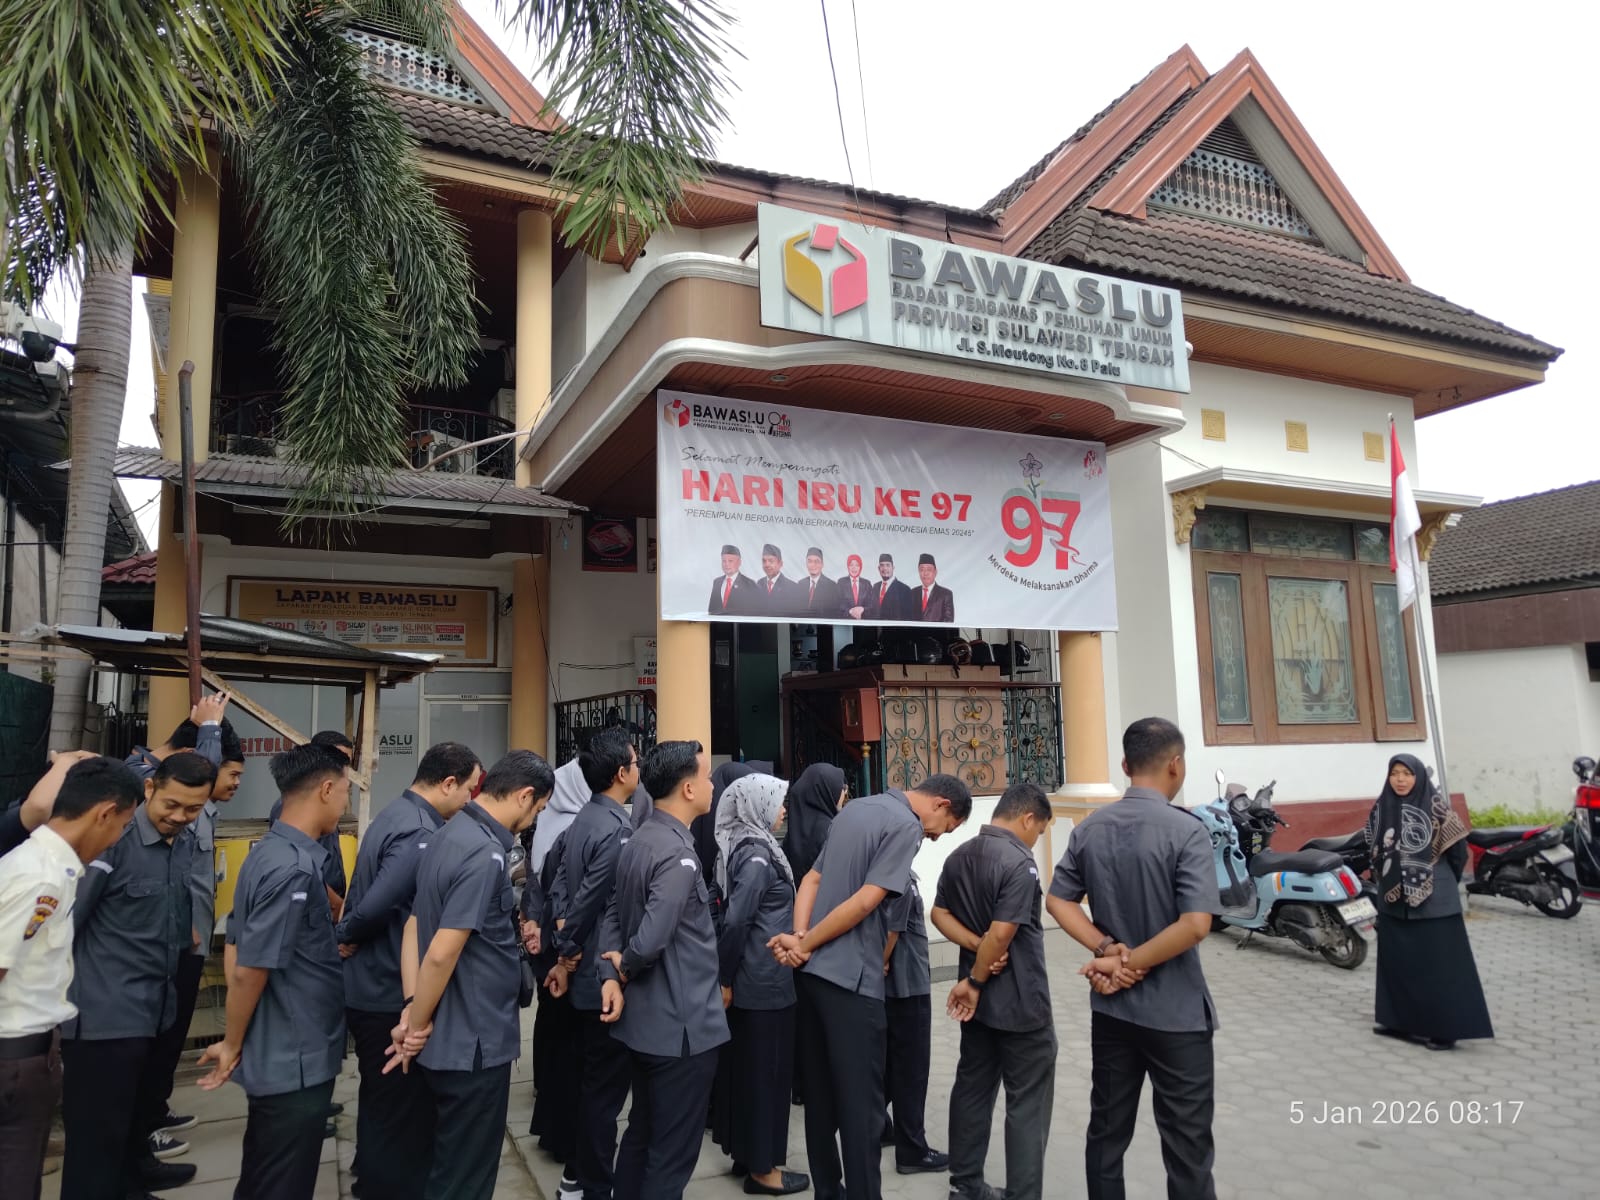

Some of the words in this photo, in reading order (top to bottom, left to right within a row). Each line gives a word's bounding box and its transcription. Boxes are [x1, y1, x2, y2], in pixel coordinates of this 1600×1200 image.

[888, 238, 1173, 328] BAWASLU
[892, 281, 949, 307] BADAN
[955, 294, 1039, 323] PENGAWAS
[1043, 310, 1124, 338] PEMILIHAN
[1130, 326, 1173, 346] UMUM
[893, 301, 989, 336] PROVINSI
[998, 321, 1093, 354] SULAWESI
[1101, 339, 1175, 368] TENGAH
[1091, 359, 1121, 377] Palu
[693, 404, 765, 425] BAWASLU
[682, 469, 785, 508] HARI
[797, 479, 862, 514] IBU
[875, 486, 921, 519] KE
[931, 491, 973, 522] 97
[744, 513, 785, 525] BERDAYA
[852, 522, 885, 532] MENUJU
[886, 524, 928, 534] INDONESIA
[929, 527, 951, 536] EMAS
[1001, 488, 1082, 571] 97
[988, 554, 1019, 583] Merdeka
[1020, 577, 1074, 592] Melaksanakan
[1074, 561, 1099, 584] Dharma
[276, 588, 351, 604] LAPAK
[359, 591, 457, 607] BAWASLU
